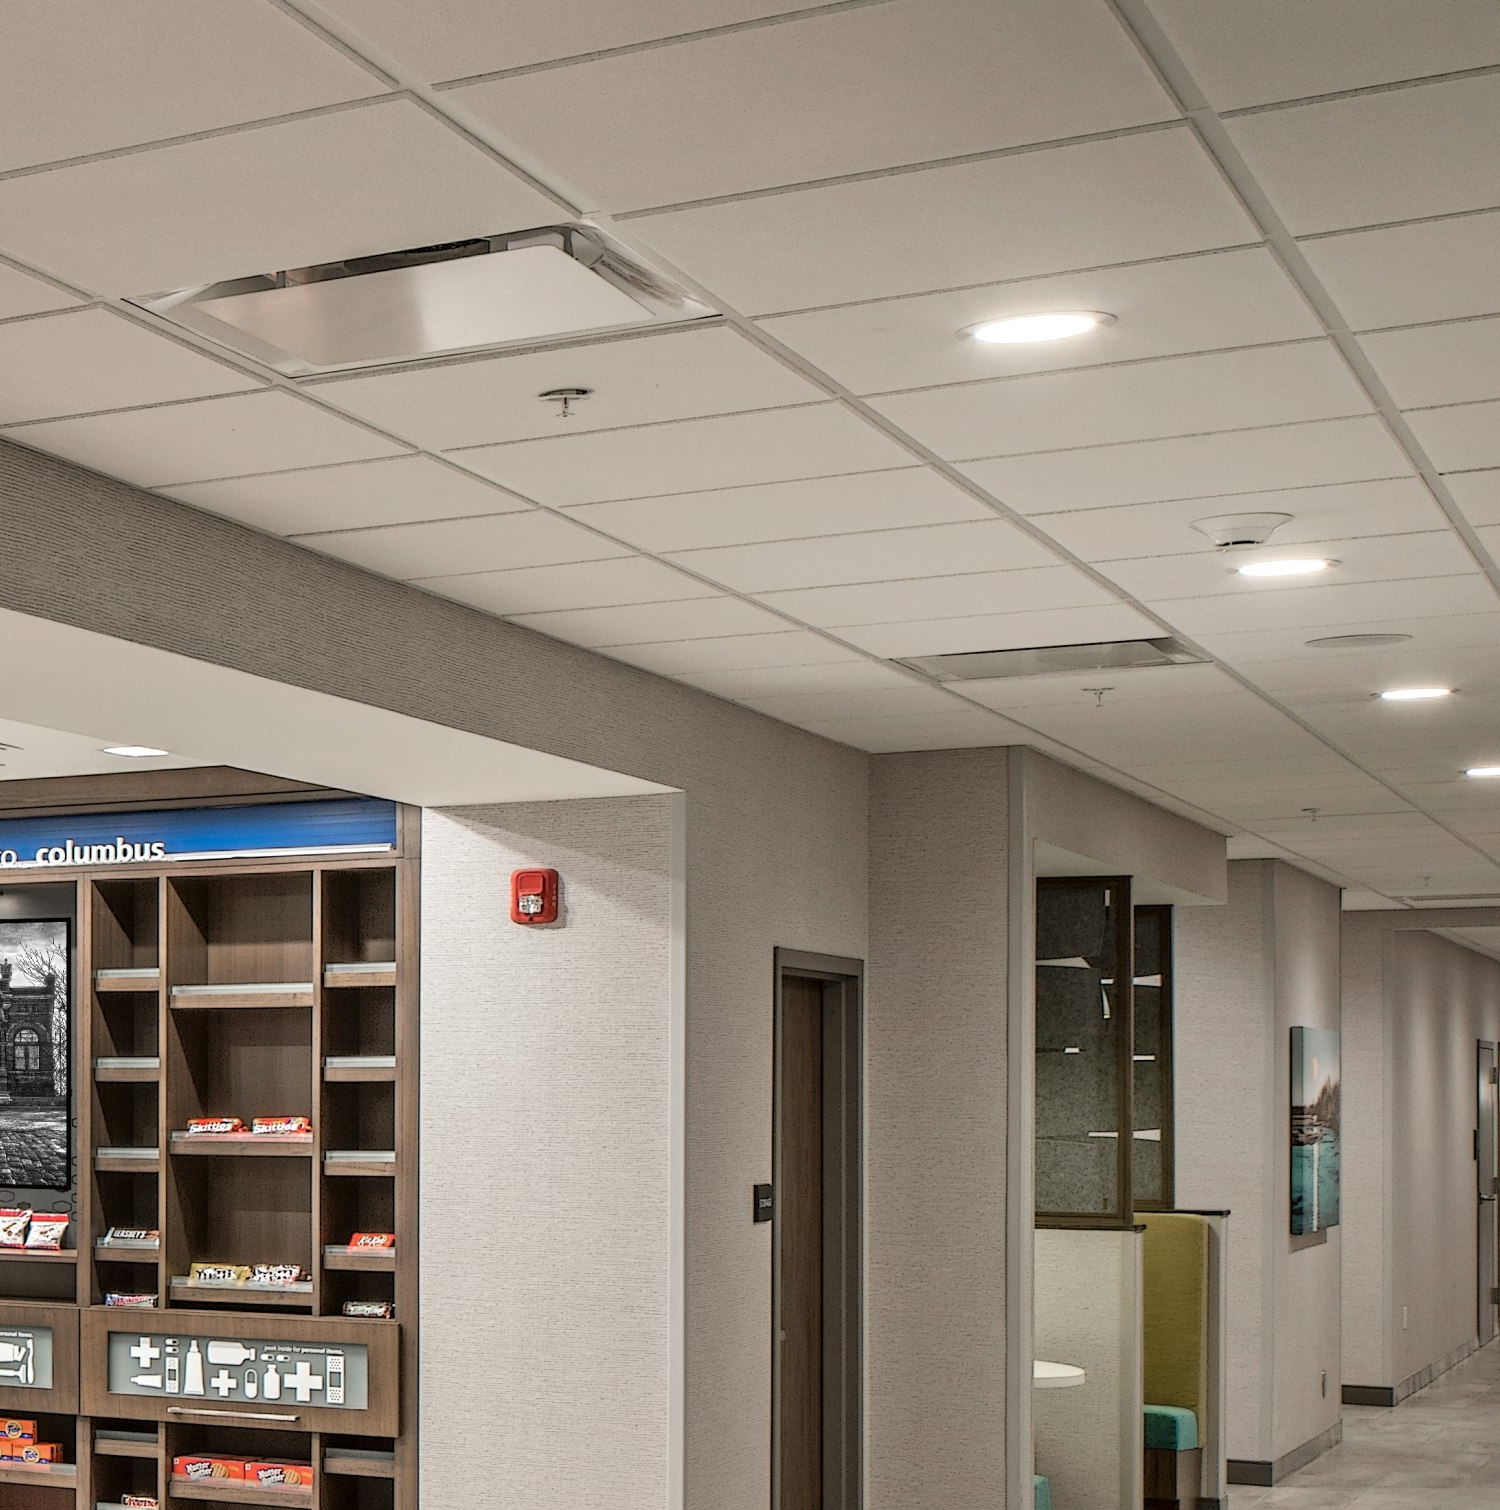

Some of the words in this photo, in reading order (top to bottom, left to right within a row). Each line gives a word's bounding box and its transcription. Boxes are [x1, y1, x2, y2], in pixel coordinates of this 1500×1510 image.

[35, 836, 166, 865] columbus
[188, 1122, 233, 1133] Skittles
[252, 1121, 300, 1134] Skittles
[7, 1424, 20, 1434] Tide
[24, 1450, 38, 1459] Tide
[185, 1462, 211, 1474] Nutter
[257, 1468, 283, 1480] Nutter
